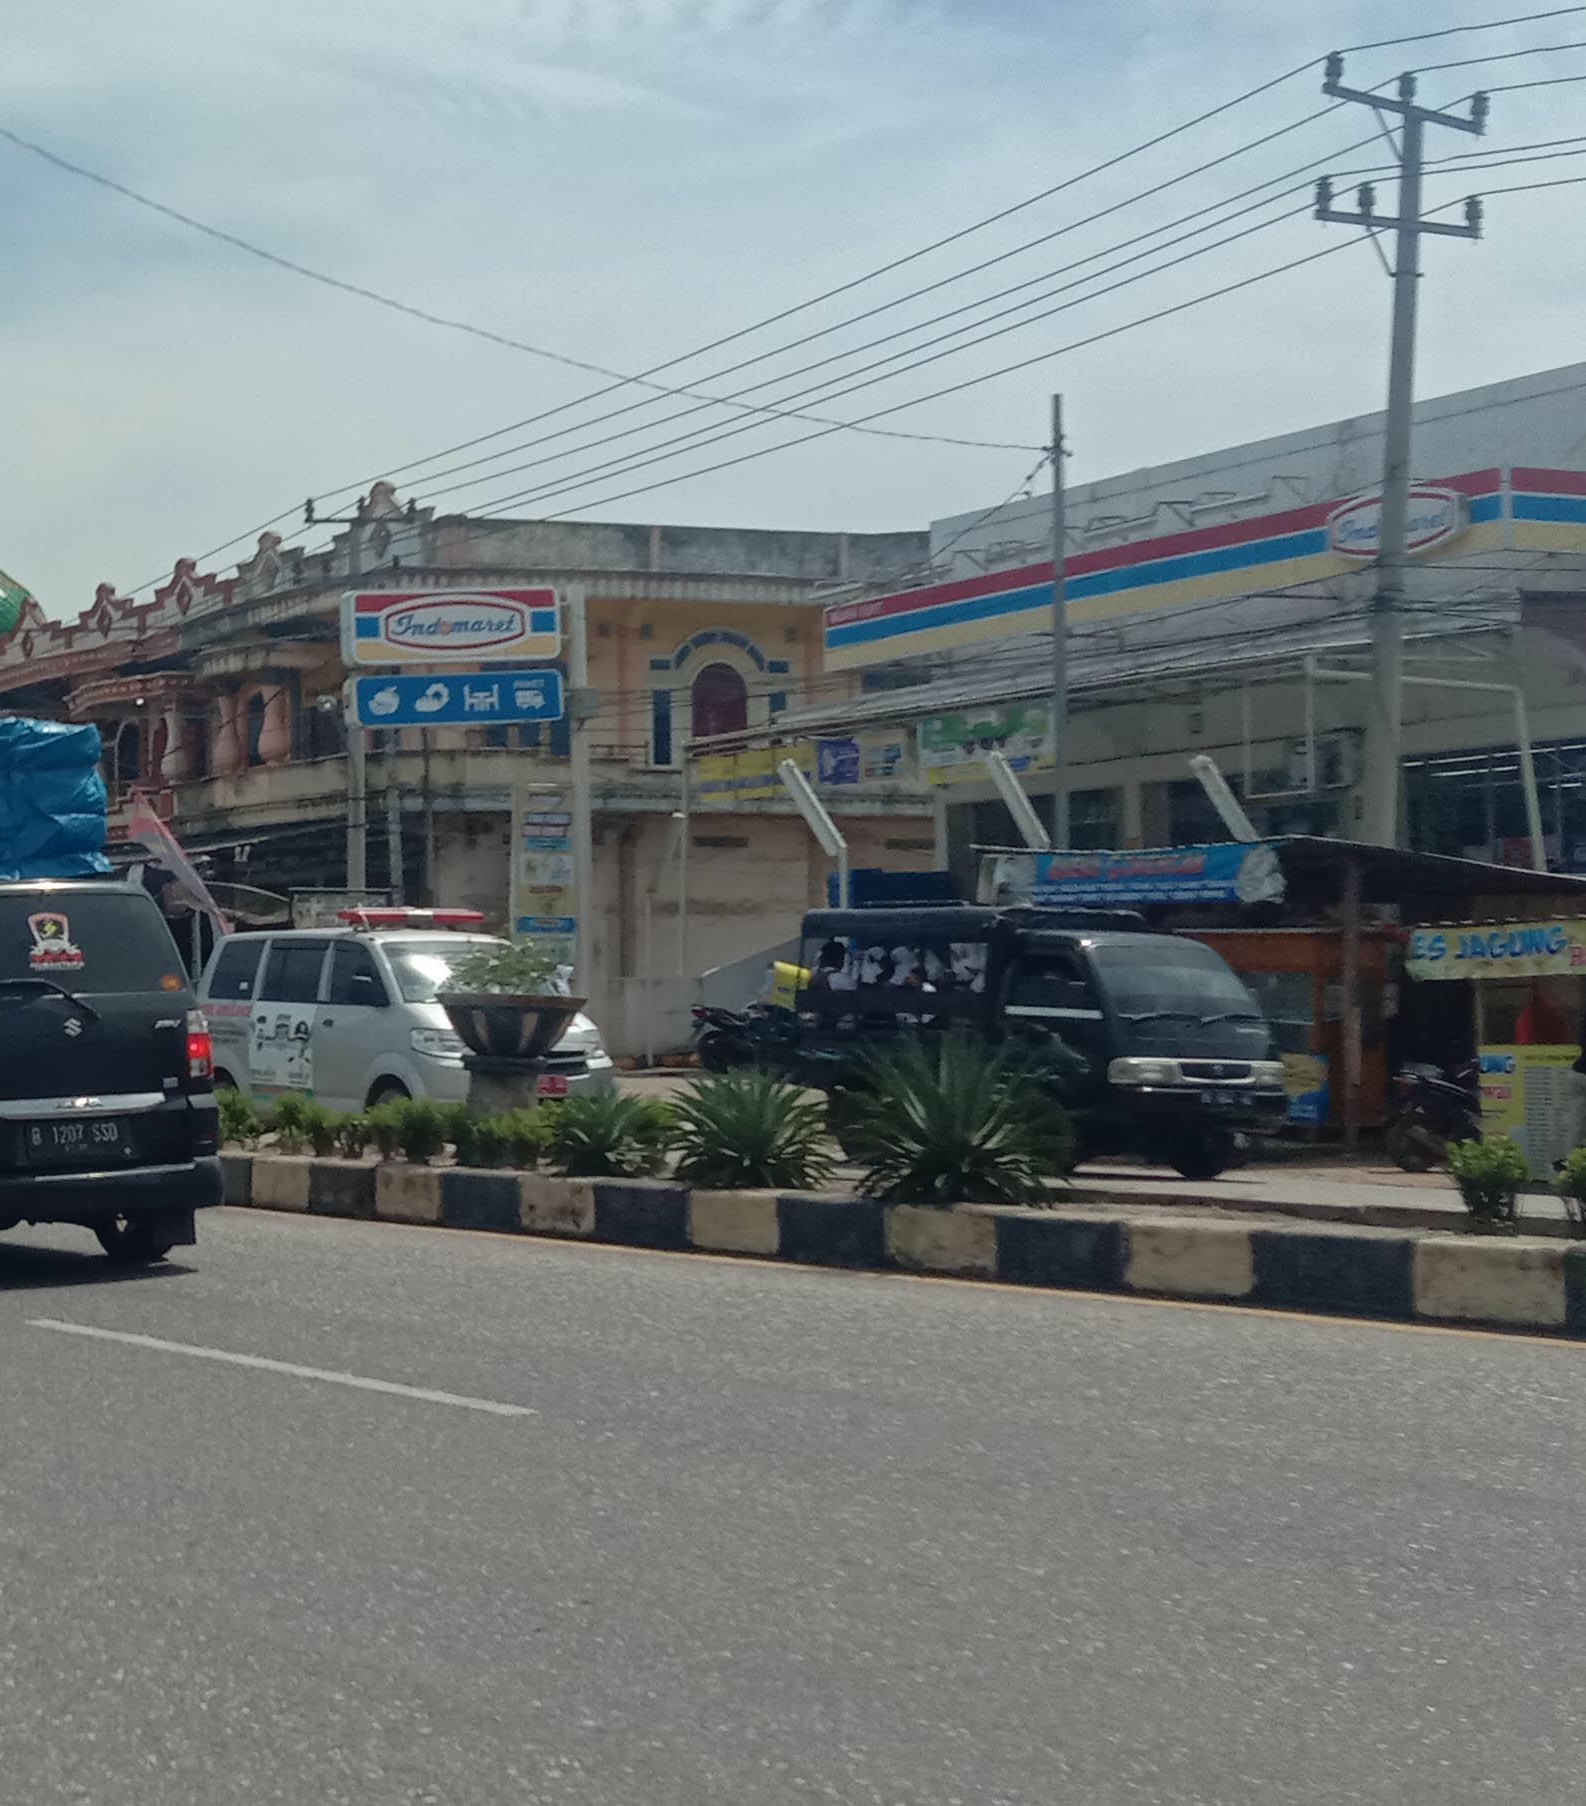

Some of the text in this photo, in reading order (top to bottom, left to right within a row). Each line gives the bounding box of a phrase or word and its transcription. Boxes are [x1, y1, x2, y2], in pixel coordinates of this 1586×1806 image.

[391, 613, 516, 636] Indomaret
[1413, 934, 1447, 961] ES
[1455, 924, 1568, 960] JAGUNG
